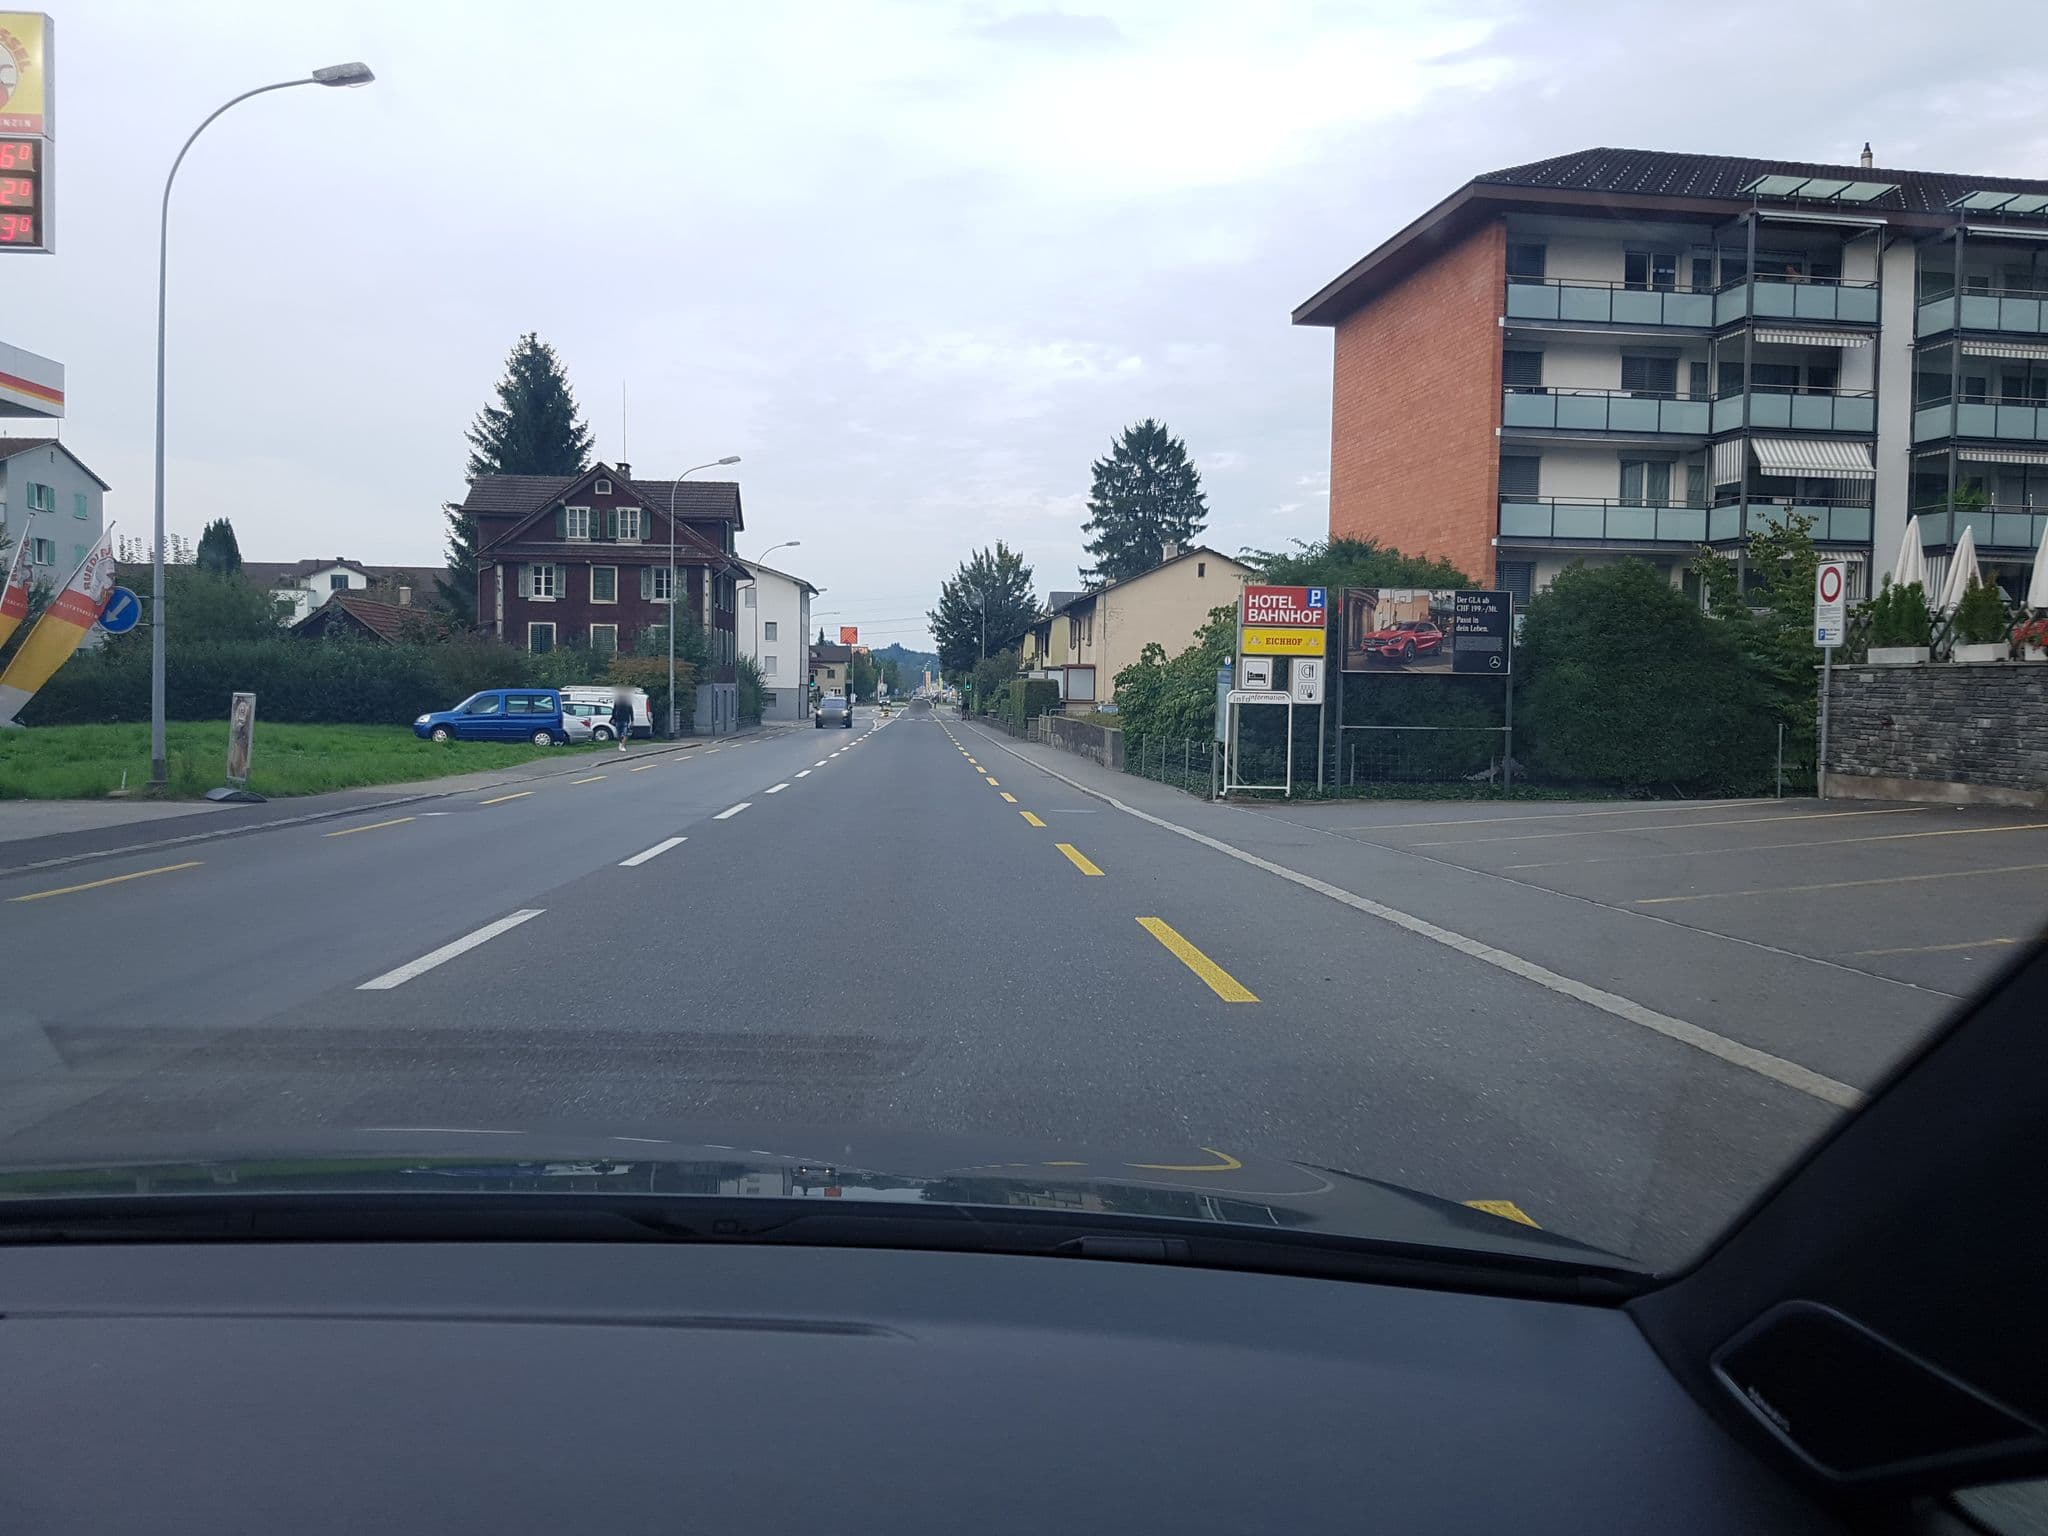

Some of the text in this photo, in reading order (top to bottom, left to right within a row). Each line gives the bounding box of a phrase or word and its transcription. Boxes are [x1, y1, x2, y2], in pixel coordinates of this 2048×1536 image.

[1248, 595, 1297, 609] HOTEL
[1248, 608, 1322, 623] BAHNHOF
[1265, 637, 1303, 646] EICHHOF
